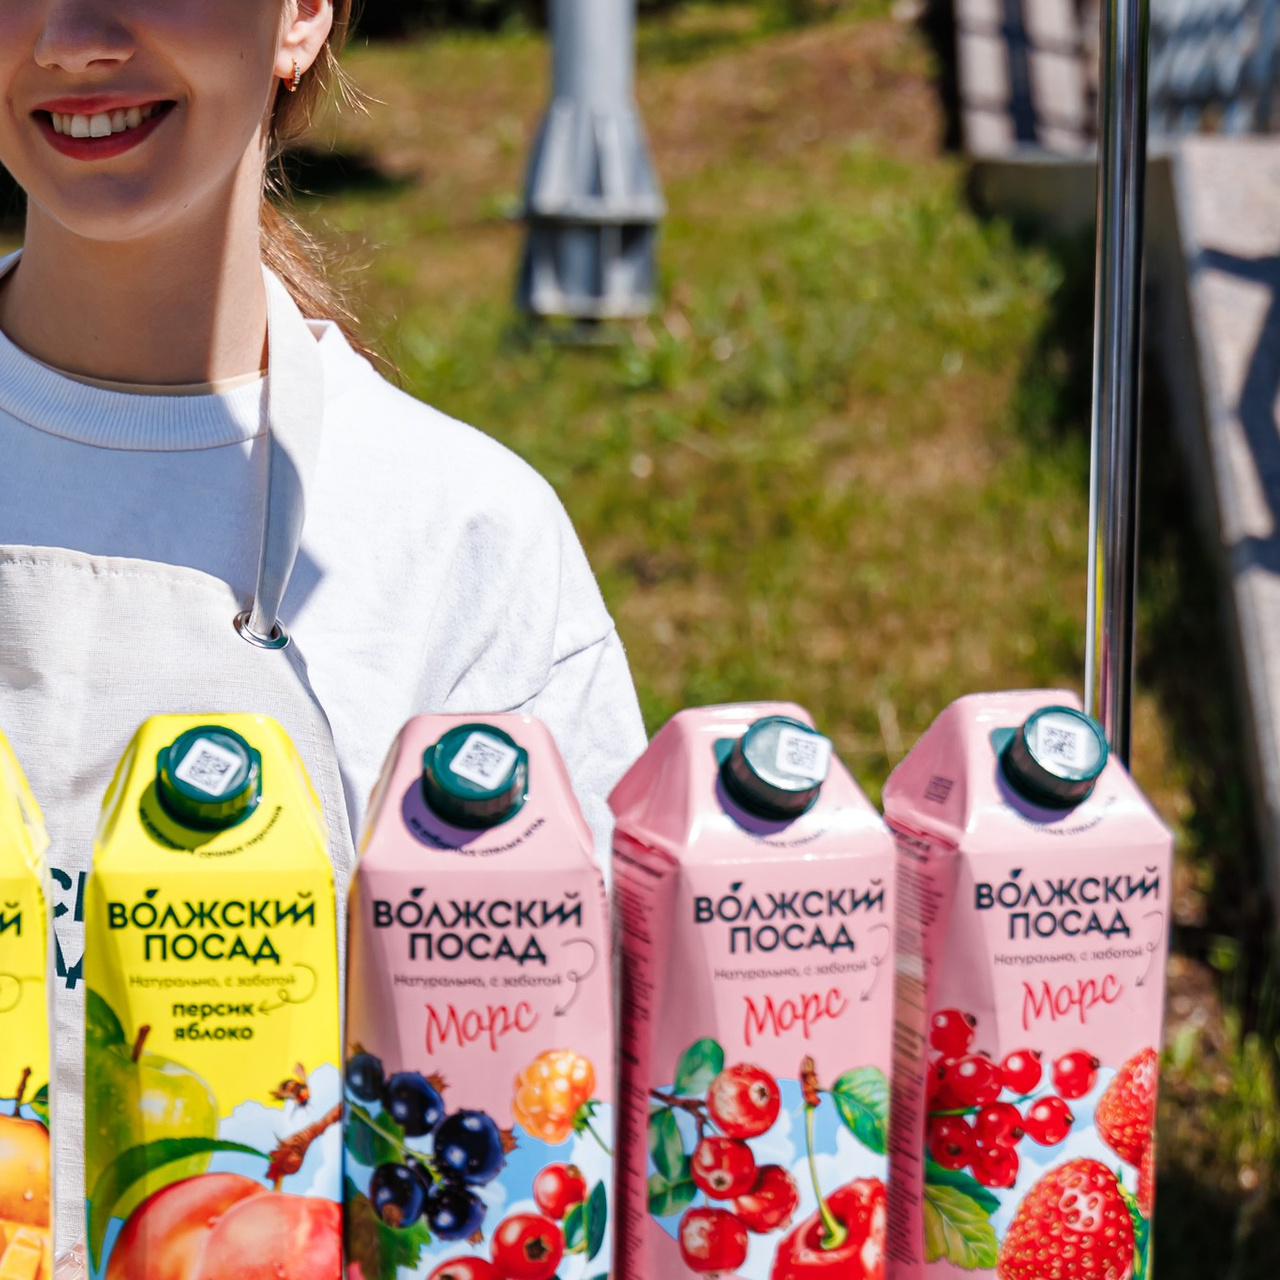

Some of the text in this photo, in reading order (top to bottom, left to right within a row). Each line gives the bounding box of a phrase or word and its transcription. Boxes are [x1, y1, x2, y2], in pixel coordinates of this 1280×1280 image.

[694, 879, 884, 923] ВОЛЖСКИЙ
[974, 866, 1160, 910] ВОЛЖСКИЙ
[108, 889, 316, 930] ВОЛЖСКИЙ
[373, 888, 582, 928] ВОЛЖСКИЙ
[1009, 910, 1130, 940] ПОСАД
[145, 934, 280, 965] ПОСАД
[409, 933, 546, 965] ПОСАД
[730, 924, 855, 954] ПОСАД
[993, 946, 1143, 966] Натурально, с заботой
[172, 1002, 254, 1020] персик
[743, 988, 848, 1047] Морс
[1022, 973, 1124, 1031] Морс
[174, 1023, 253, 1041] яблоко
[424, 1001, 539, 1055] Морс
